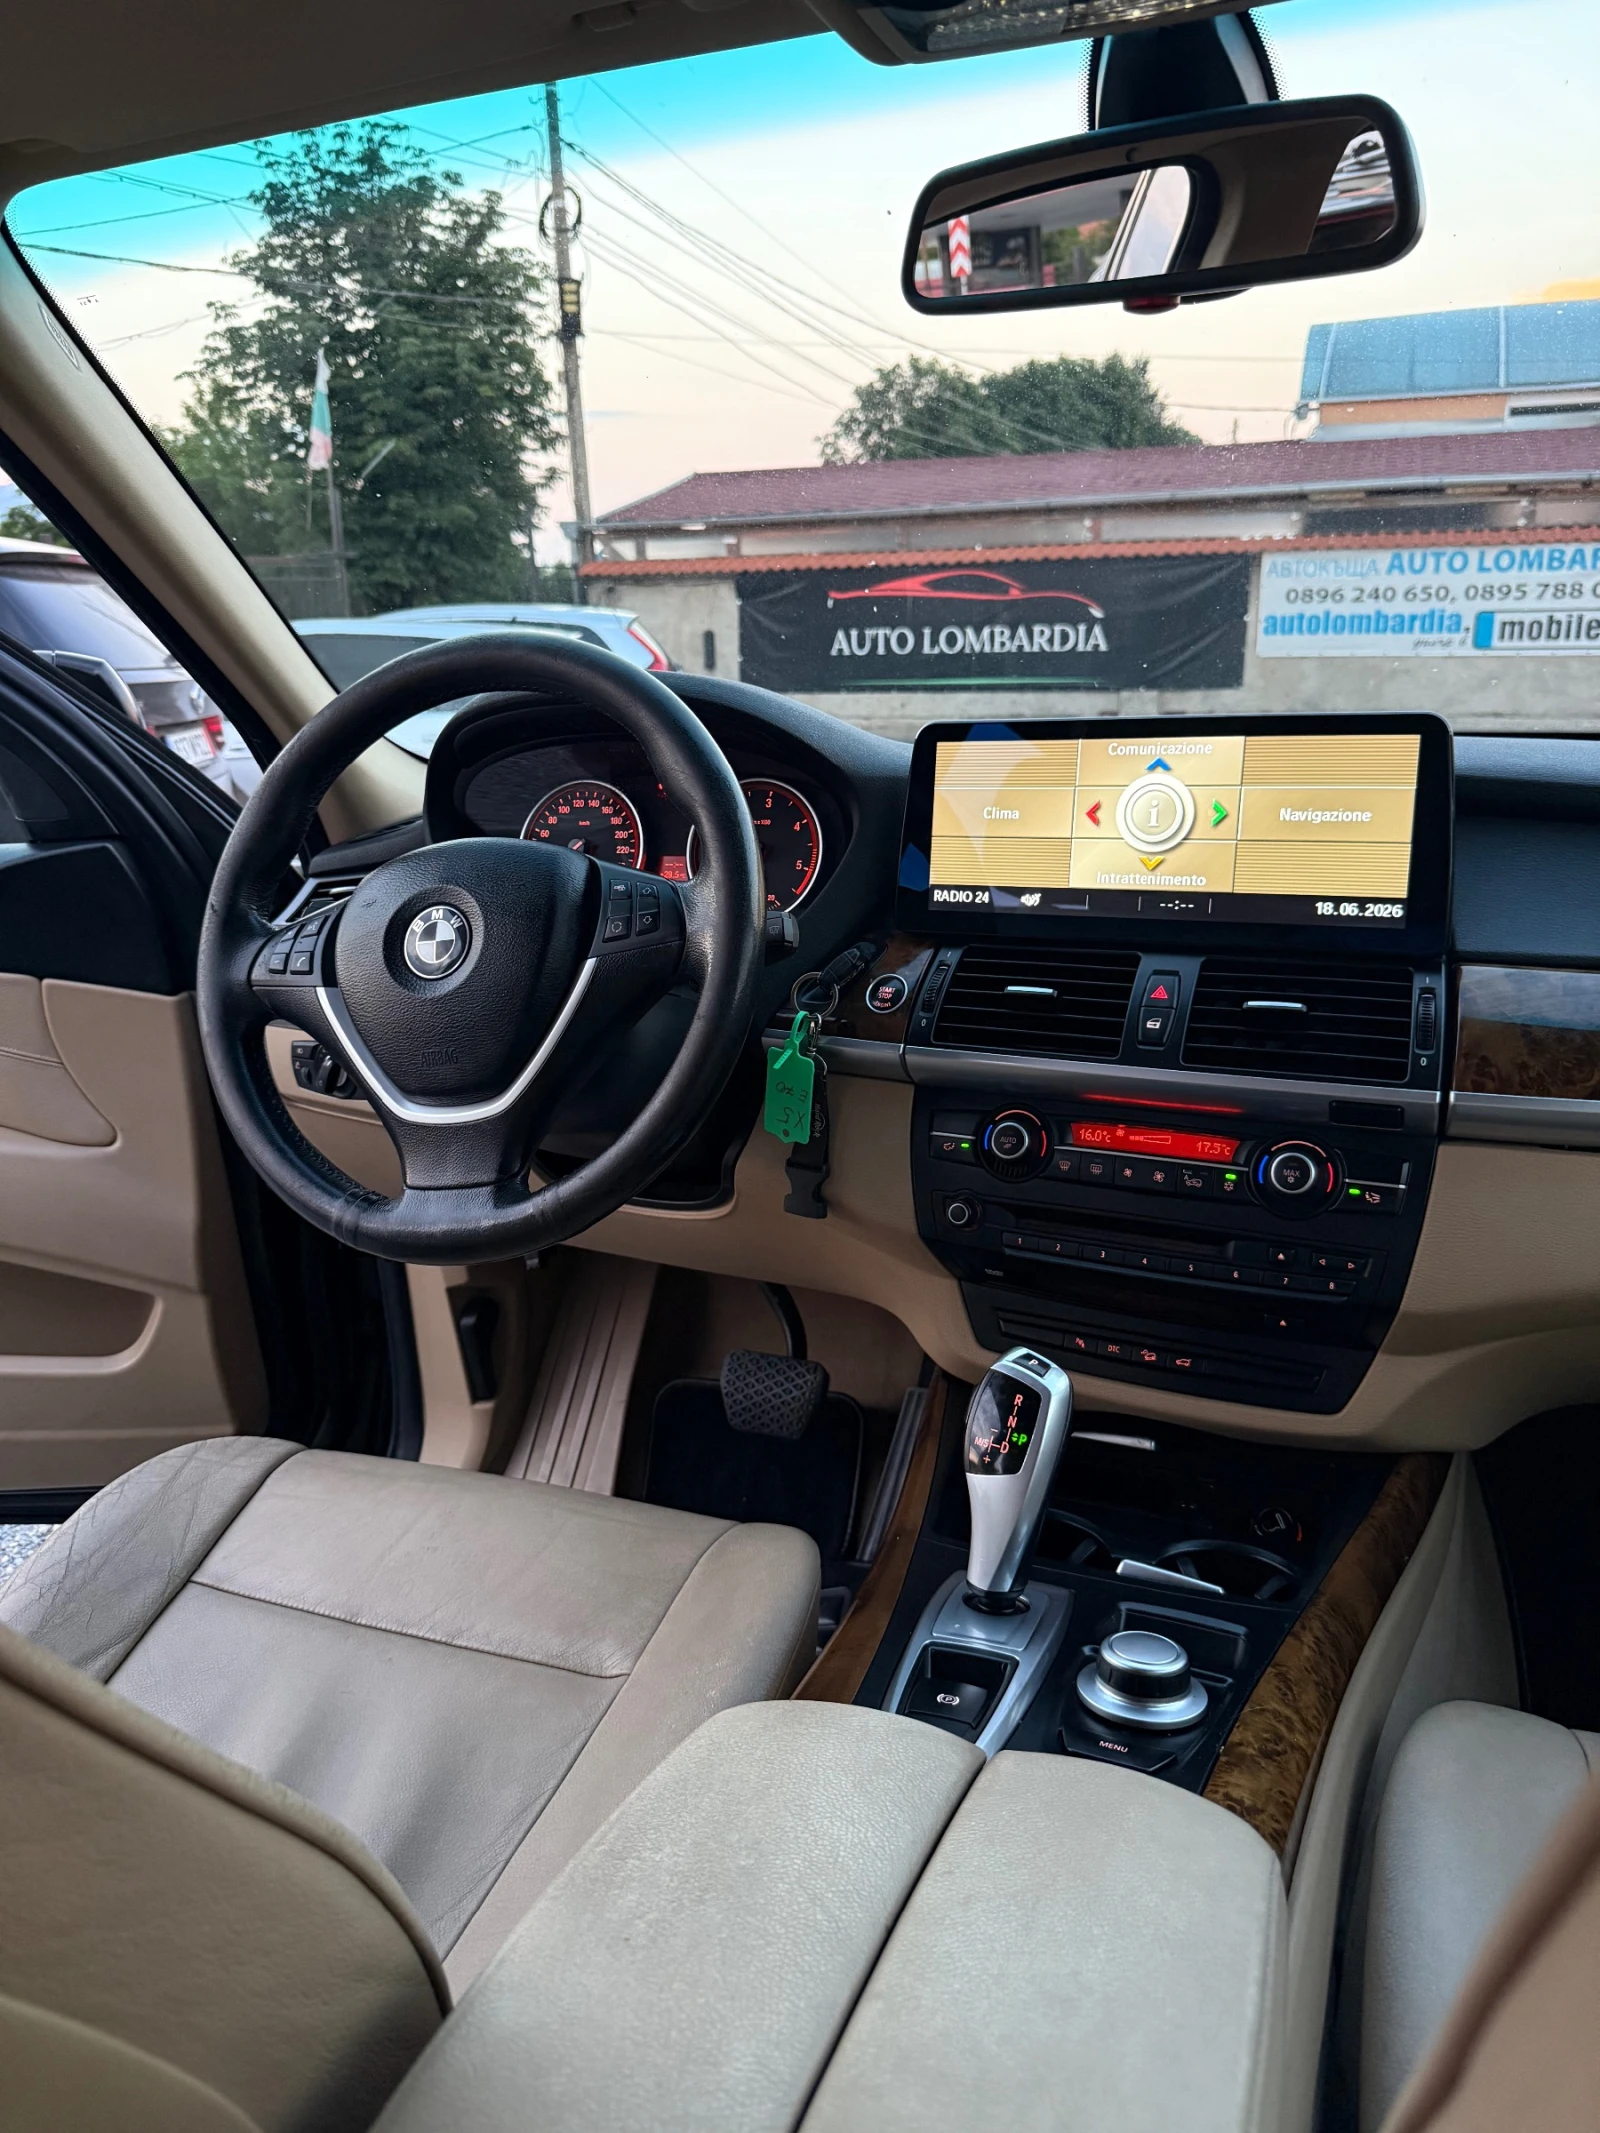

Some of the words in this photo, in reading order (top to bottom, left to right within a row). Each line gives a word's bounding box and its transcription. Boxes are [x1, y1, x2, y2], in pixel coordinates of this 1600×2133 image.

[1385, 549, 1469, 575] AUTO
[1286, 587, 1344, 605] 0896
[1353, 586, 1396, 603] 240
[1465, 583, 1527, 601] 0895
[1536, 582, 1583, 600] 788
[830, 626, 915, 656] AUTO
[921, 621, 1109, 655] LOMBARDIA
[1107, 742, 1213, 756] Comunicazione
[572, 799, 585, 808] 120
[588, 799, 600, 808] 140
[765, 798, 772, 808] 3
[558, 806, 570, 814] 100
[601, 806, 614, 814] 160
[982, 806, 1020, 820] Clima
[548, 816, 558, 824] 80
[610, 816, 623, 825] 180
[1279, 808, 1373, 825] Navigazione
[794, 821, 801, 831] 4
[540, 830, 550, 838] 60
[614, 829, 629, 839] 200
[616, 845, 630, 854] 220
[795, 860, 803, 870] 5
[1096, 872, 1206, 887] Intrattenimento
[934, 890, 973, 904] RADIO
[974, 891, 989, 904] 24
[1314, 901, 1403, 918] 18.06.2026
[411, 909, 463, 933] BMW
[420, 1049, 459, 1067] AIRBAG
[999, 1136, 1017, 1144] AUTO
[1282, 1168, 1300, 1177] MAX
[1056, 1243, 1061, 1251] 2
[1100, 1250, 1105, 1258] 3
[1142, 1257, 1147, 1265] 4
[1188, 1264, 1194, 1272] 5
[1283, 1277, 1289, 1285] 7
[1329, 1282, 1335, 1290] 8
[1029, 1358, 1038, 1366] P
[1013, 1394, 1023, 1406] R
[1007, 1416, 1017, 1428] N
[1017, 1434, 1027, 1445] P
[974, 1436, 989, 1448] M/S
[999, 1442, 1009, 1454] D
[1098, 1740, 1129, 1753] MENU
